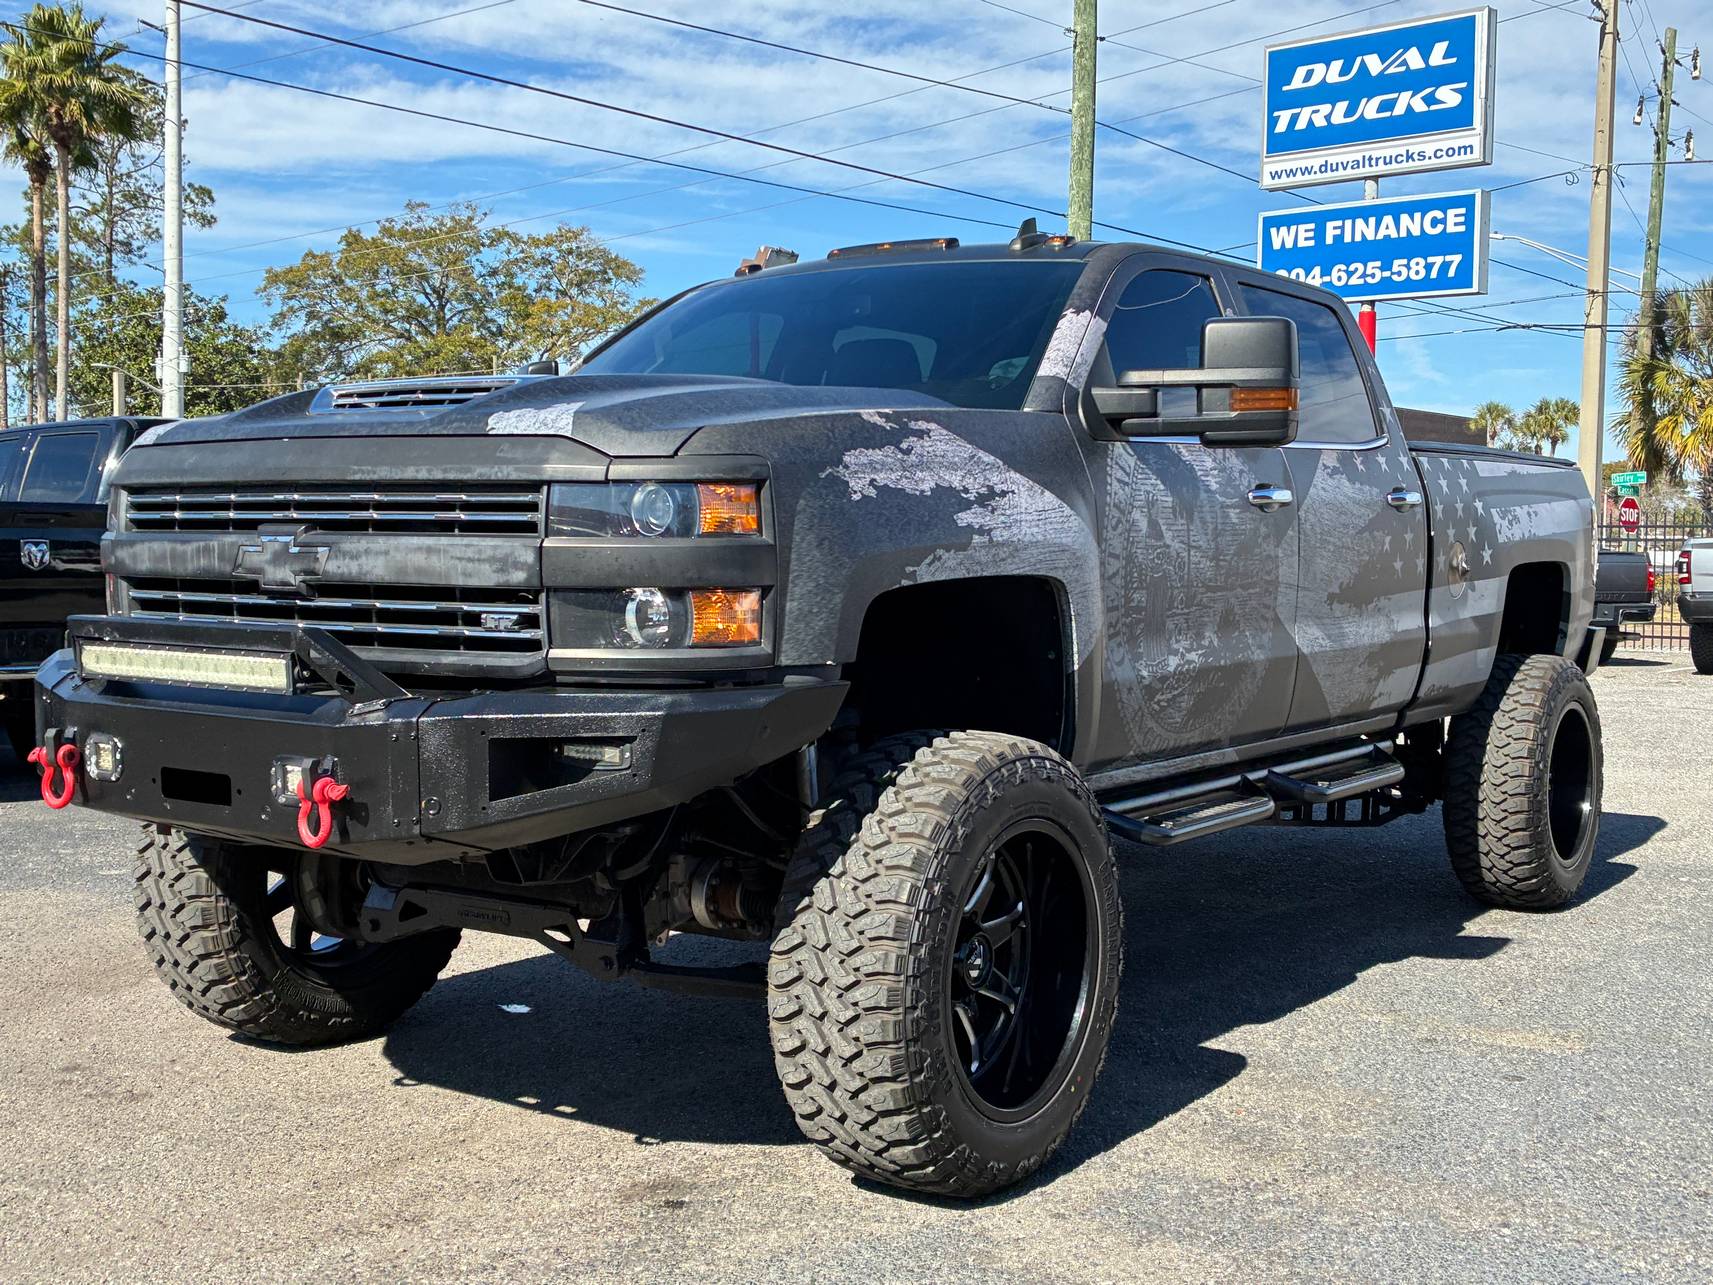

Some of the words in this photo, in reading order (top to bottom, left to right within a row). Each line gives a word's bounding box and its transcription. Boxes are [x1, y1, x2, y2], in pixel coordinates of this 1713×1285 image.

[1282, 40, 1458, 91] DUVAL
[1273, 82, 1468, 133] TRUCKS
[1269, 143, 1474, 181] www.duvaltrucks.com
[1270, 223, 1315, 250] WE
[1325, 207, 1467, 245] FINANCE
[1621, 508, 1639, 522] STOP
